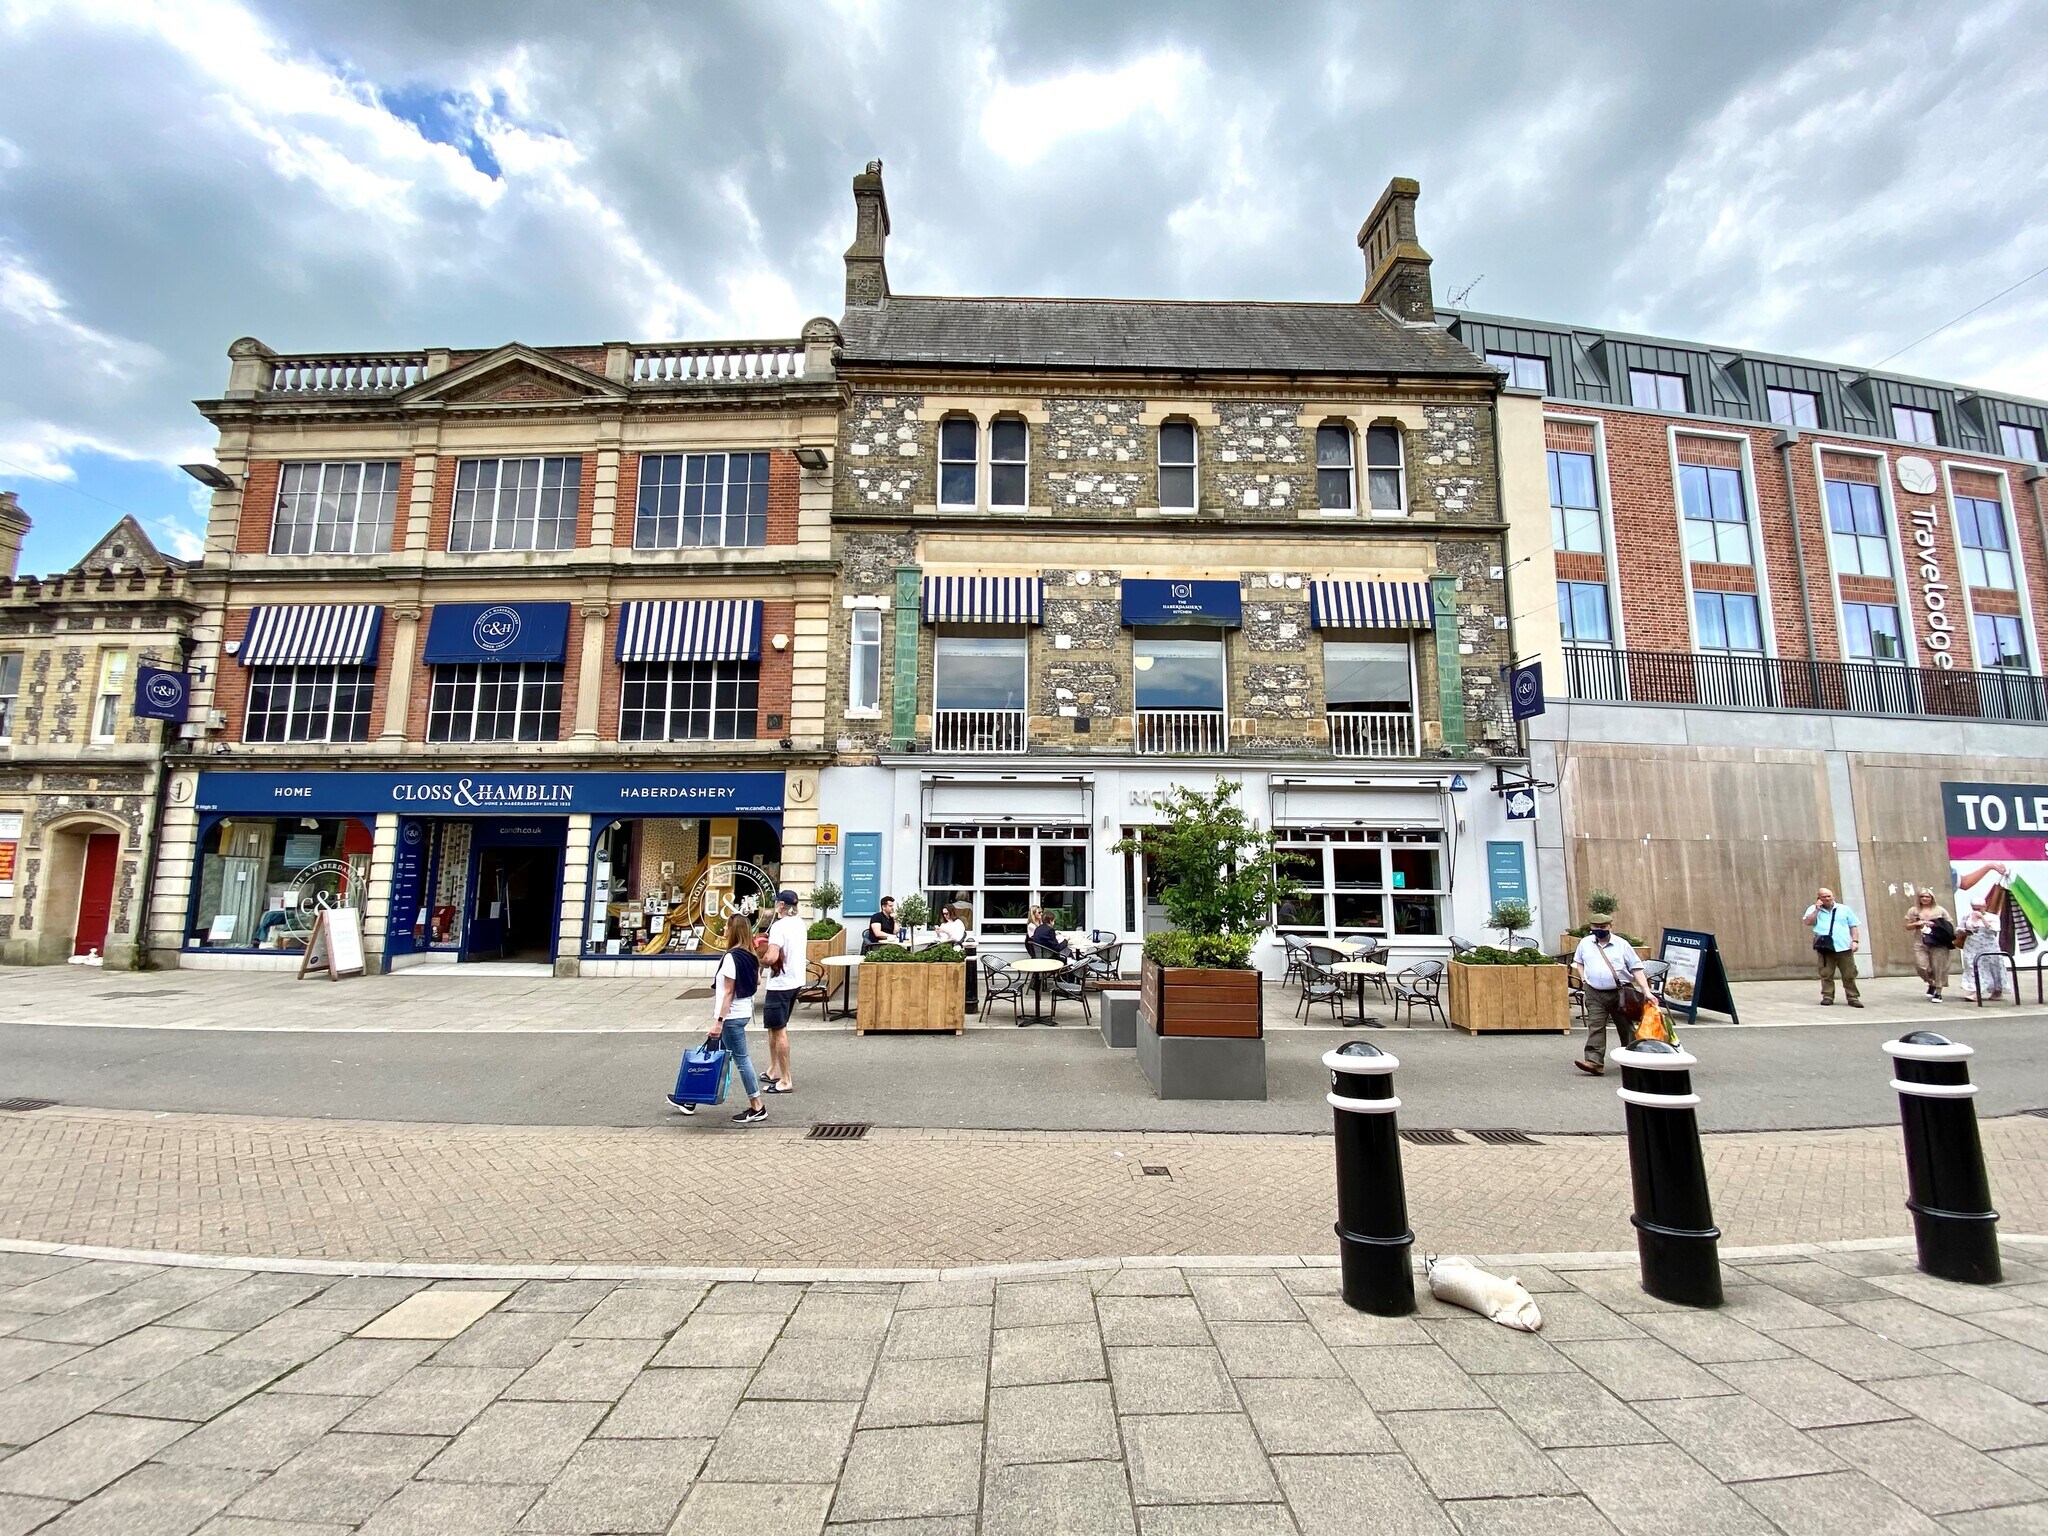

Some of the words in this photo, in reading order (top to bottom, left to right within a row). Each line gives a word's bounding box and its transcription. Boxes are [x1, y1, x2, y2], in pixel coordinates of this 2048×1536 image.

[1909, 504, 1955, 670] Travelodge
[482, 621, 512, 635] C&H
[274, 787, 313, 797] HOME
[620, 788, 736, 798] HABERDASHERY
[1956, 794, 2008, 832] TO
[499, 826, 542, 834] candh.co.uk
[1682, 938, 1700, 946] STEIN
